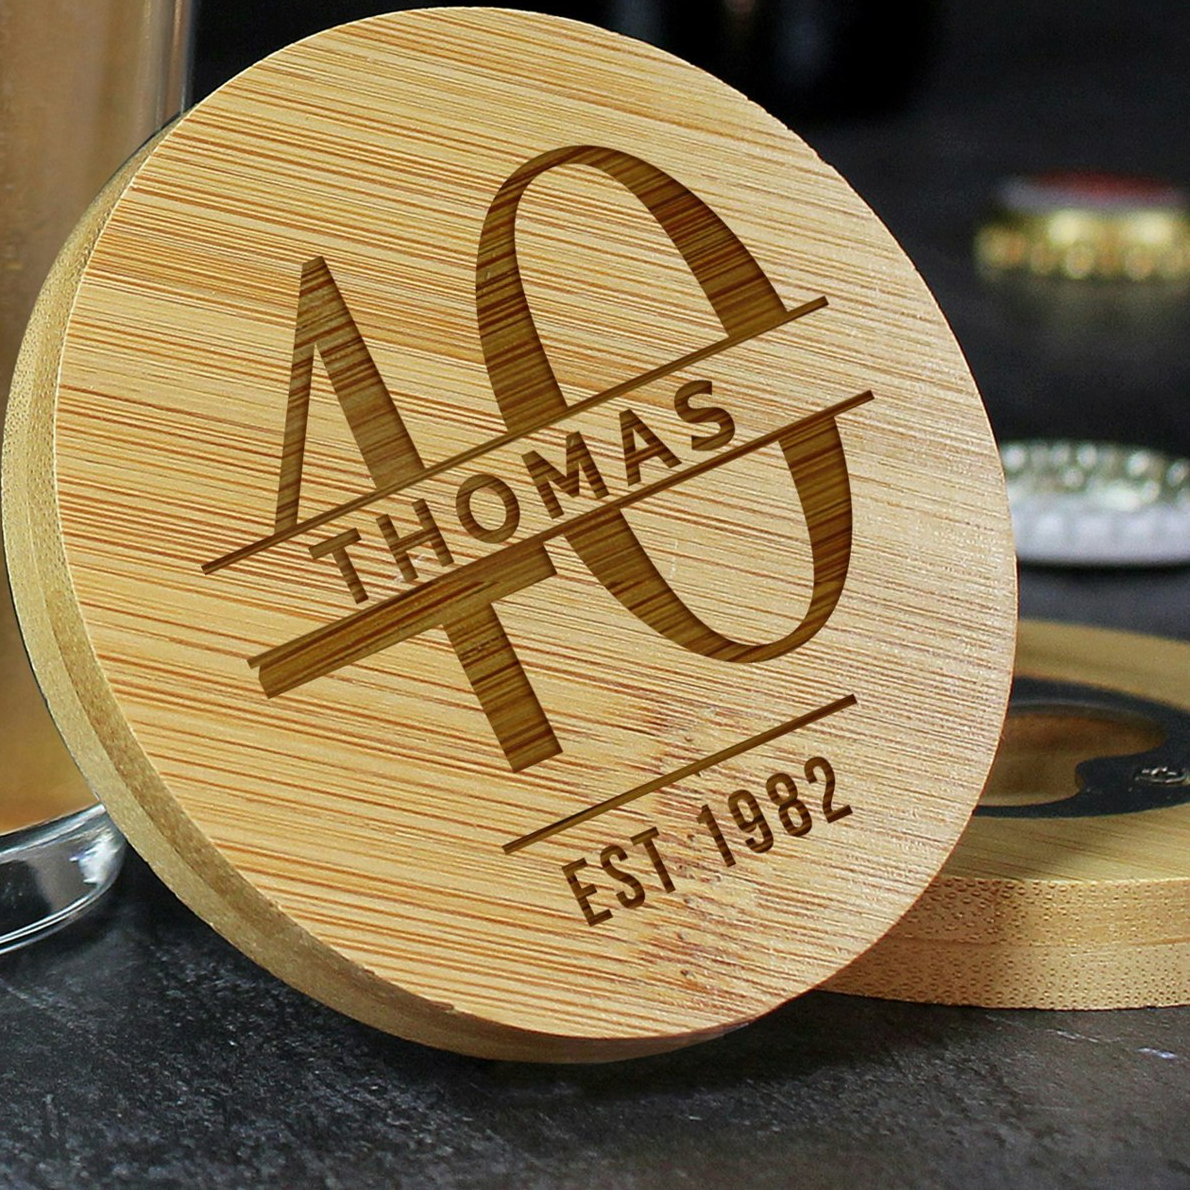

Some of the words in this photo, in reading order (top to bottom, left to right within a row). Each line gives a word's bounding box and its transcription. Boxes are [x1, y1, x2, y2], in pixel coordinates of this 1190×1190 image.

[258, 145, 853, 773] 40
[308, 380, 736, 604] THOMAS
[562, 827, 675, 927] EST
[697, 756, 853, 867] 1982
